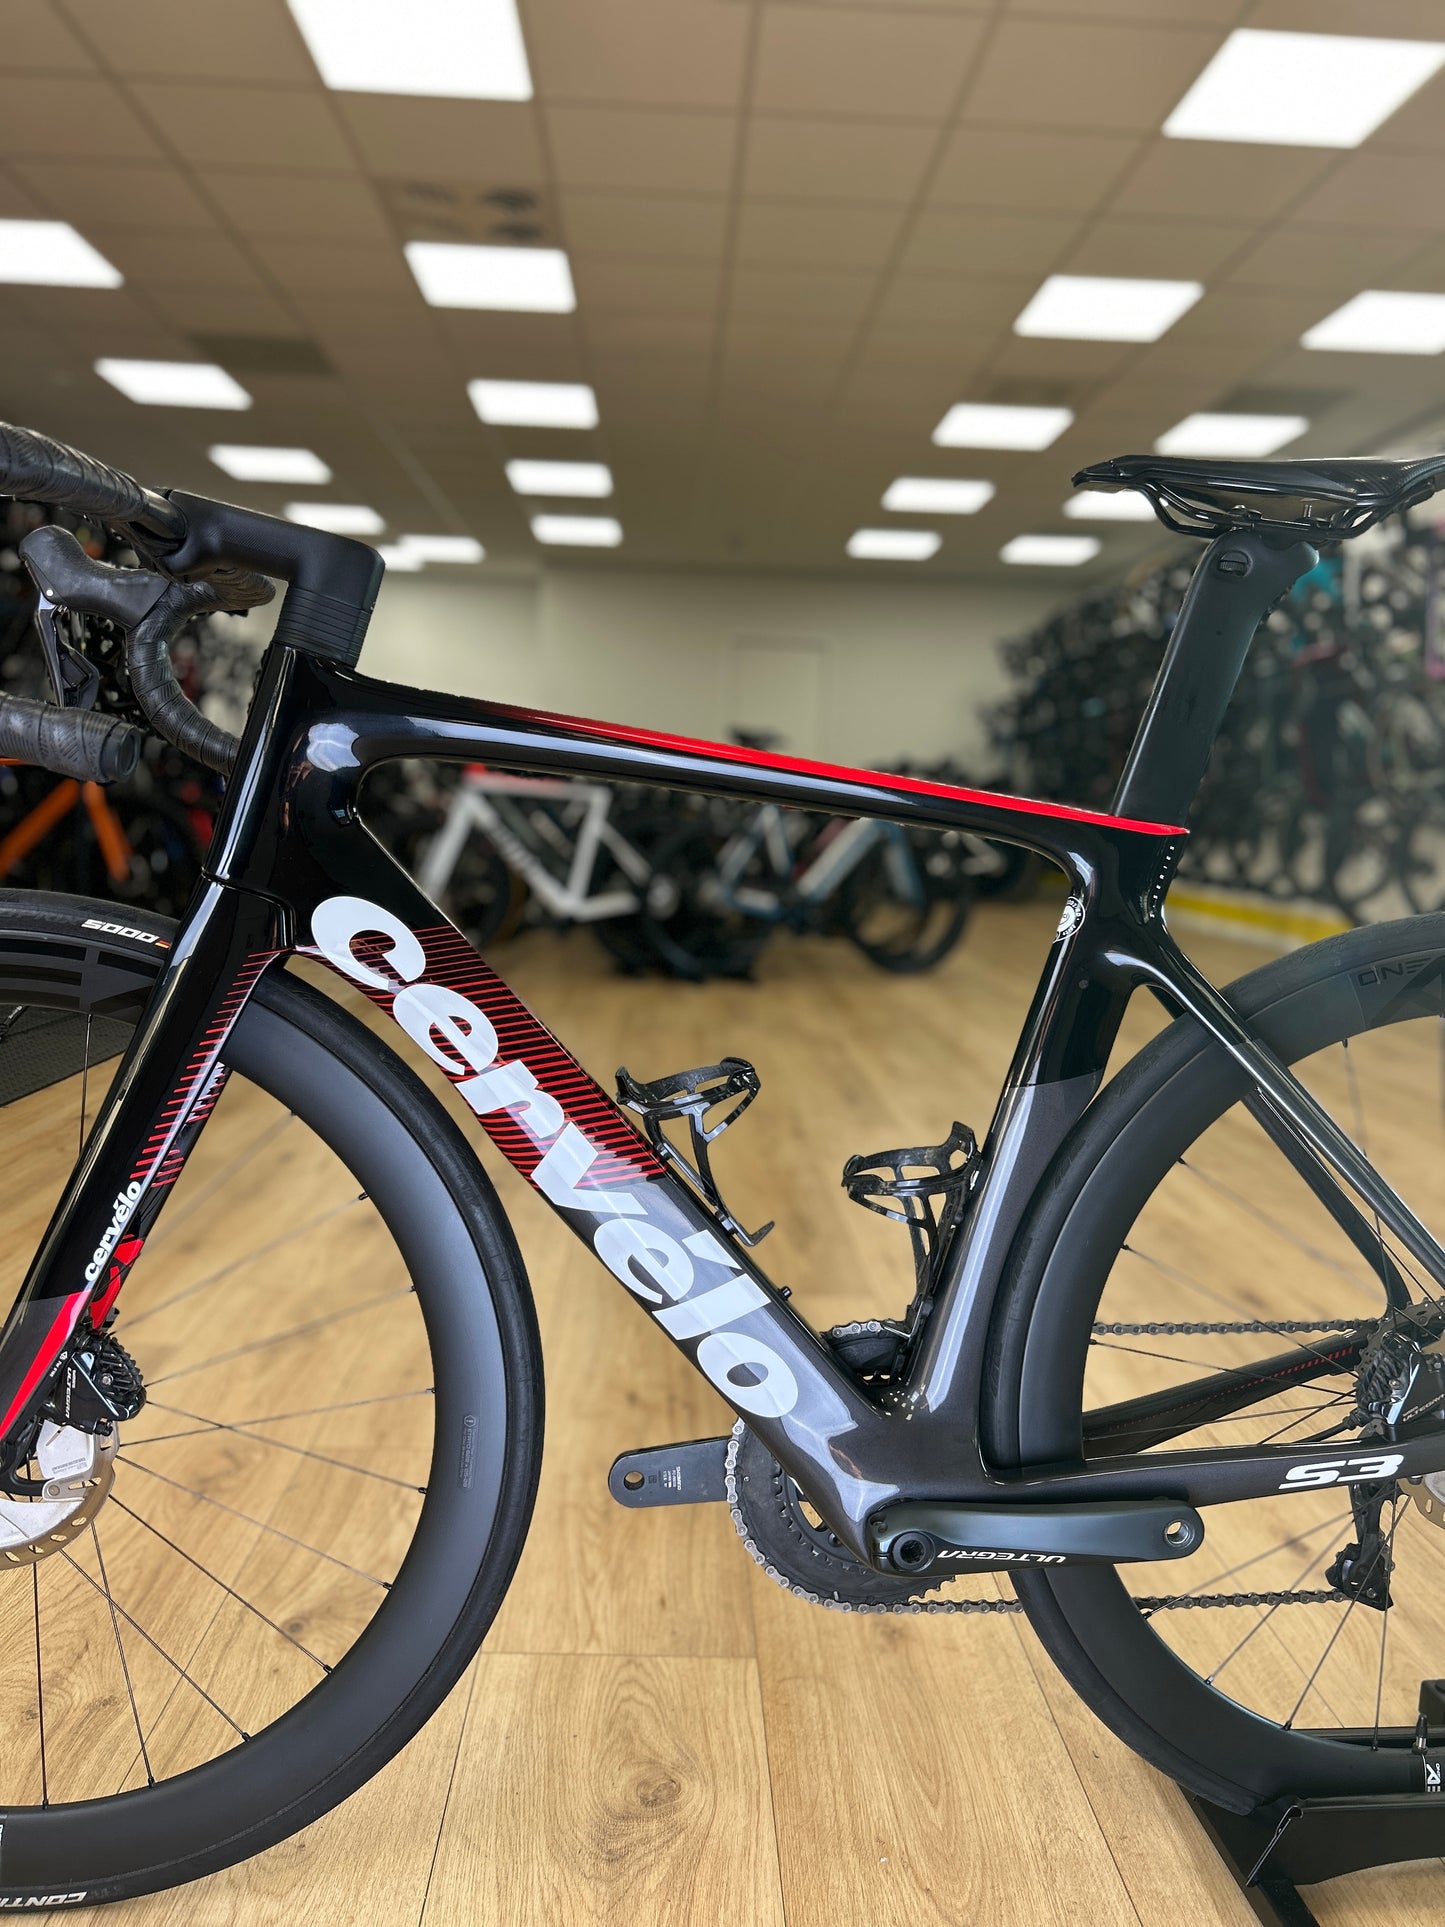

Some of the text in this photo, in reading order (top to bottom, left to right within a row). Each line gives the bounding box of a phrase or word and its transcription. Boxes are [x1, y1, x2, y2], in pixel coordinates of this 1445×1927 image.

[81, 918, 160, 943] 5000
[310, 895, 799, 1418] cervélo
[84, 1180, 142, 1283] cervélo
[1278, 1454, 1405, 1490] S3
[936, 1550, 1067, 1563] ULTEGRA
